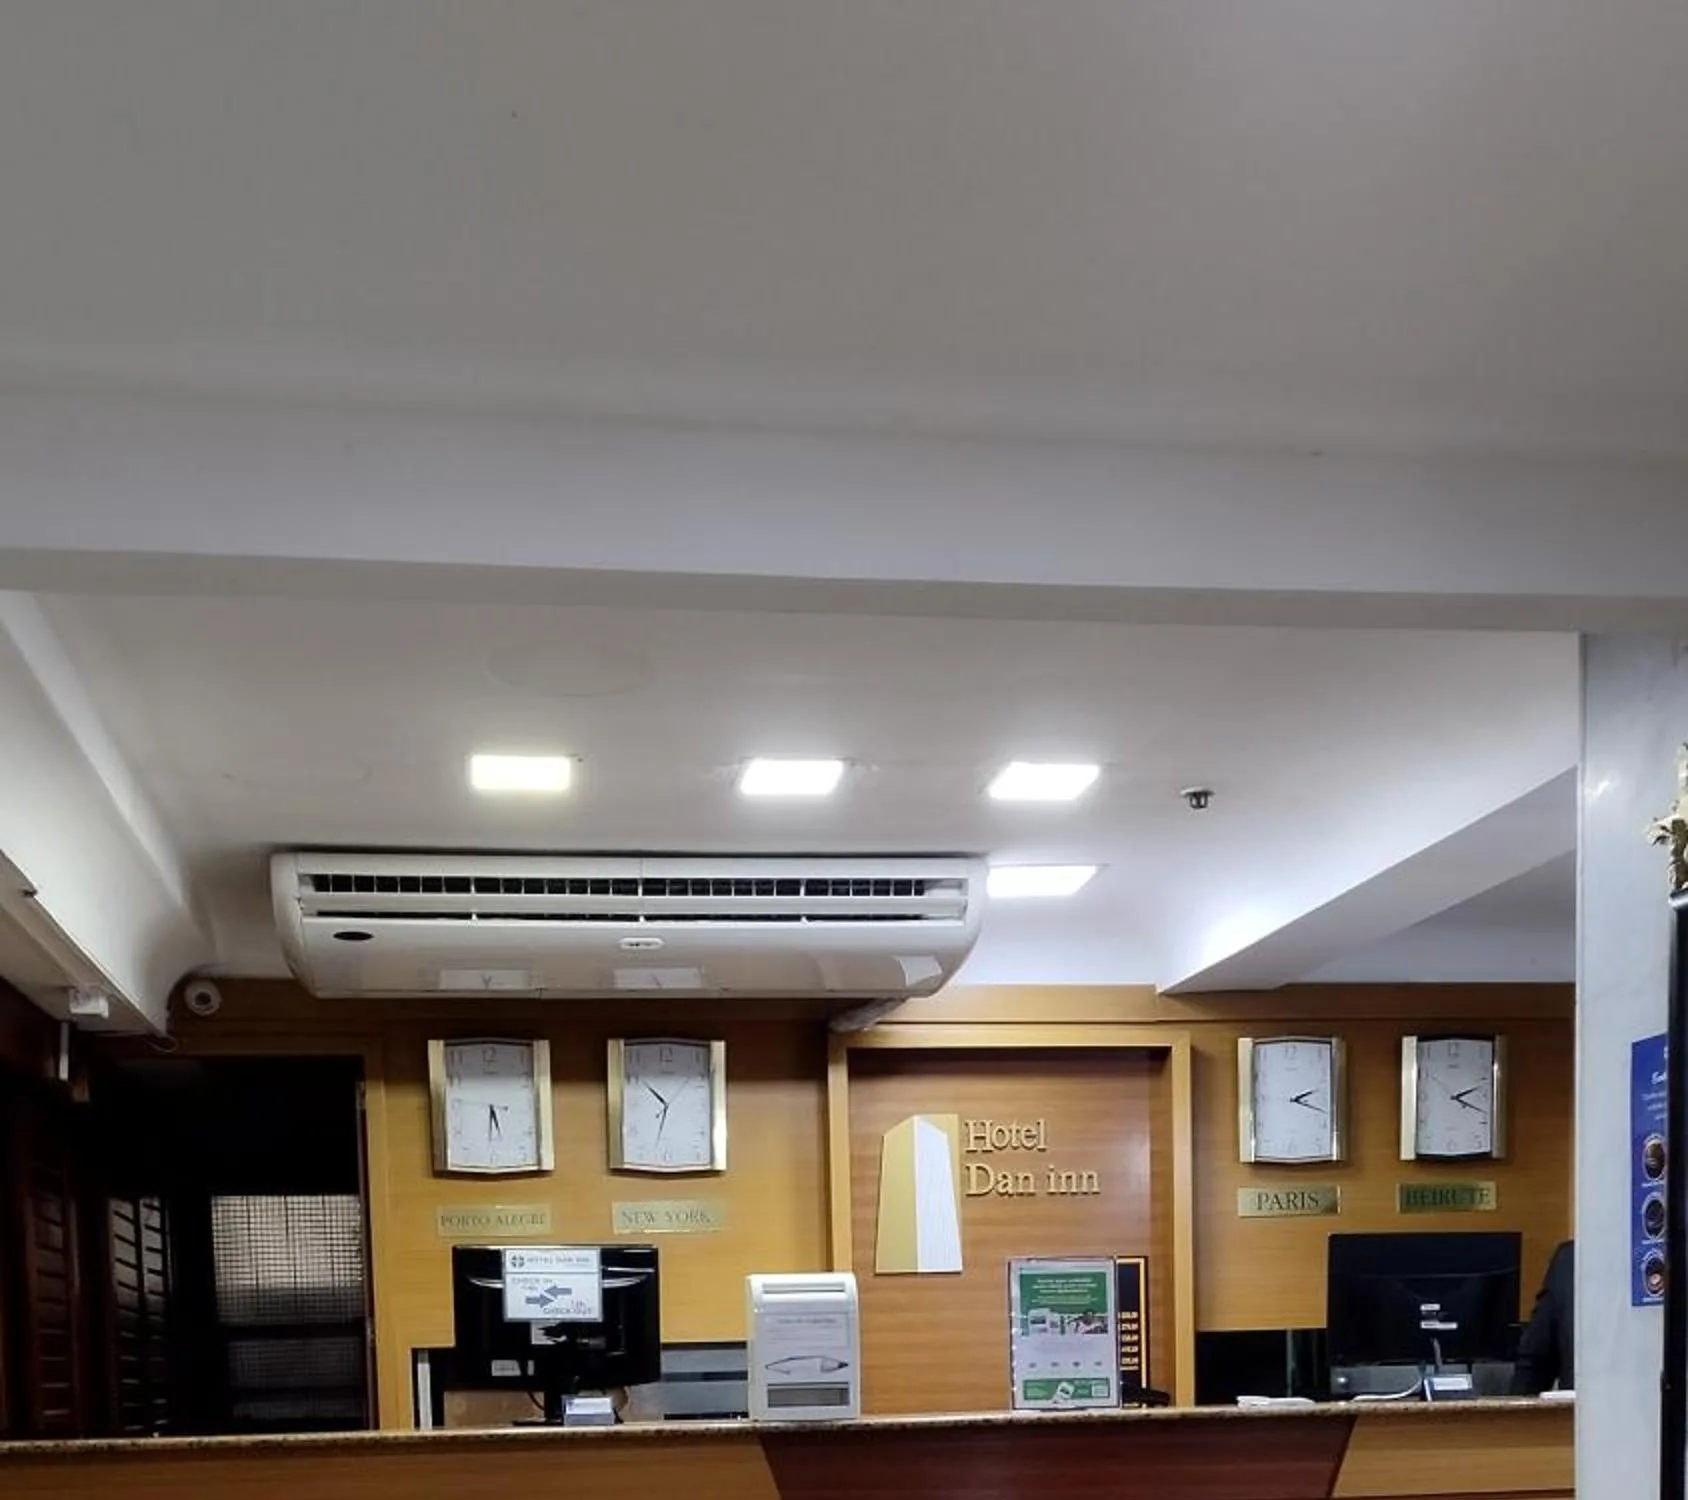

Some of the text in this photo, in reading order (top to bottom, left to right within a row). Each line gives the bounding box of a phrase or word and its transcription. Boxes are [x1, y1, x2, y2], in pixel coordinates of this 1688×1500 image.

[965, 1118, 1047, 1152] Hotel
[965, 1163, 1101, 1197] Dan inn
[1256, 1190, 1320, 1211] PARIS
[440, 1214, 492, 1228] PORTO
[621, 1208, 712, 1225] NEW YORK
